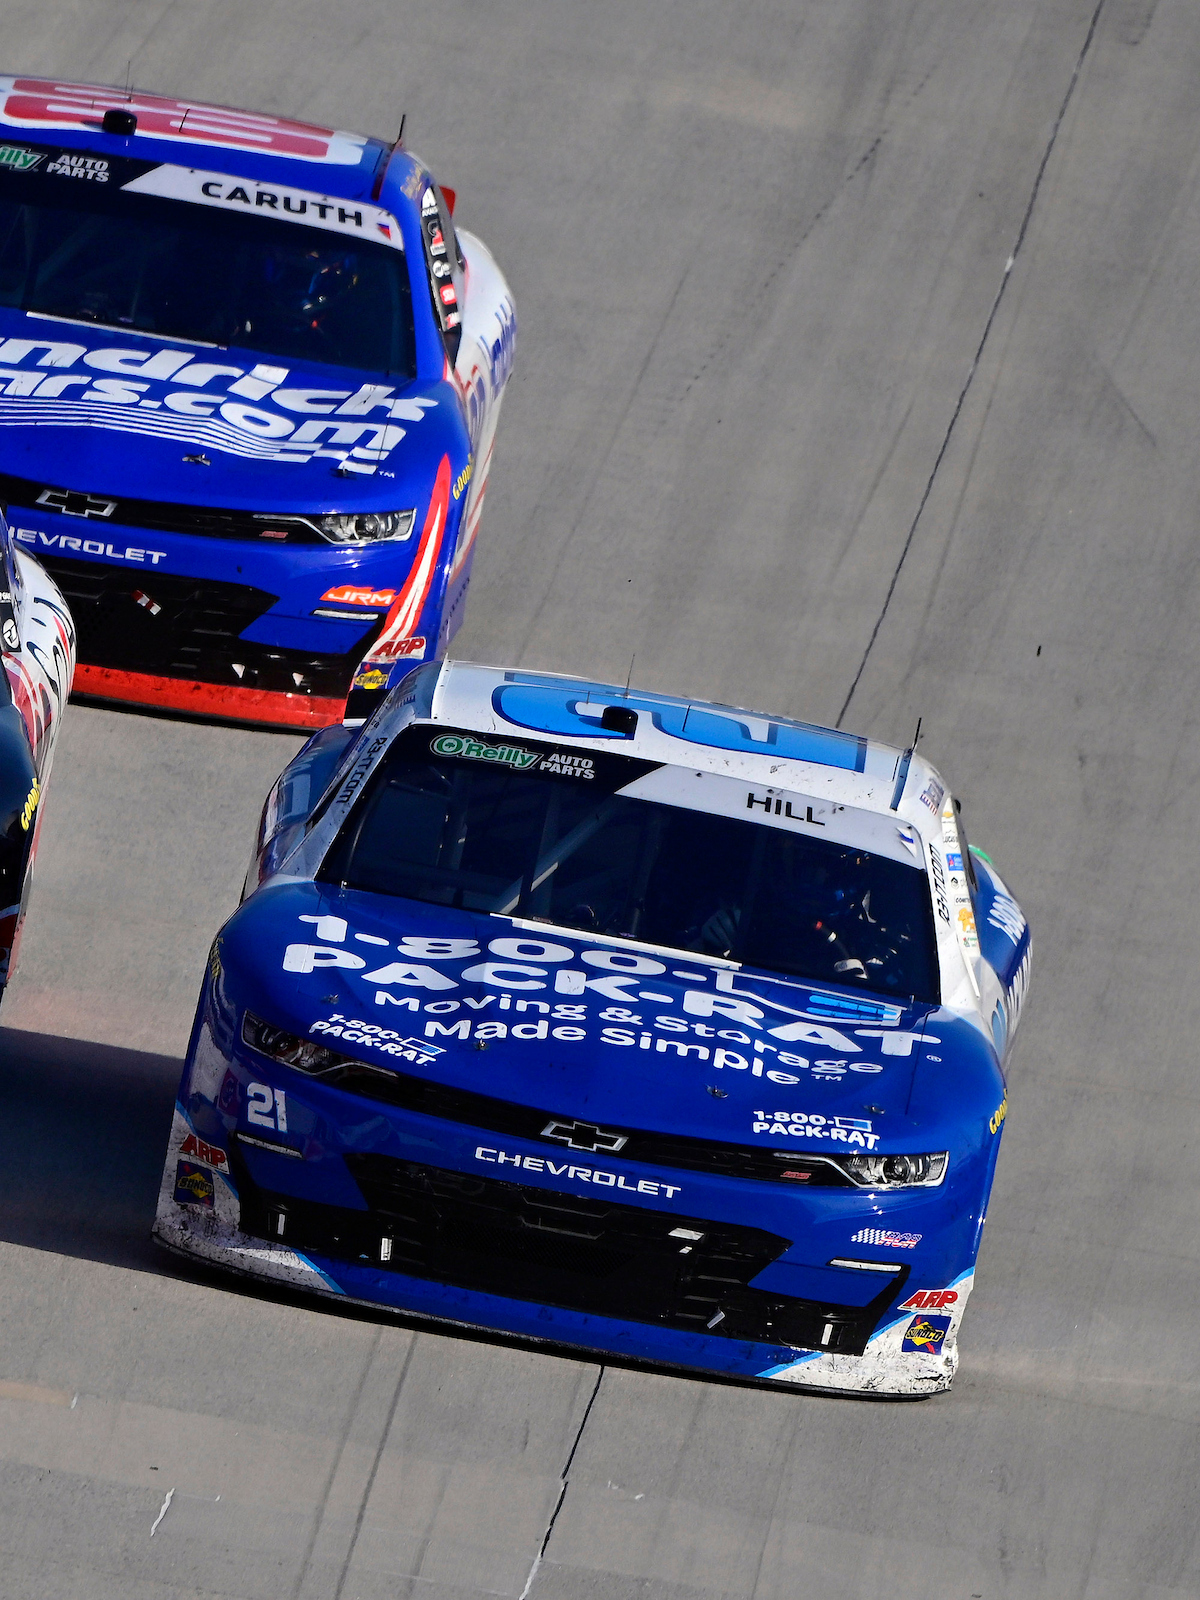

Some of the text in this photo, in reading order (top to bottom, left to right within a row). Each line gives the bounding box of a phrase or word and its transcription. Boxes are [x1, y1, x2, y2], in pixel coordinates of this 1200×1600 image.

[46, 162, 110, 183] PARTS
[57, 154, 109, 172] AUTO
[201, 181, 363, 228] CARUTH
[328, 591, 392, 605] JRM
[373, 637, 426, 658] ARP
[356, 672, 388, 685] SUNOCO
[434, 734, 539, 768] O'Reilly
[548, 753, 594, 769] AUTO
[539, 760, 596, 780] PARTS
[746, 792, 826, 827] HILL
[282, 944, 942, 1057] PACK-RAT
[308, 1021, 438, 1065] PACK-RAT
[374, 990, 884, 1074] Moving & Storage
[424, 1019, 588, 1042] Made
[599, 1027, 801, 1086] Simple
[246, 1082, 289, 1134] 21
[179, 1134, 227, 1166] ARP
[752, 1122, 881, 1150] PACK-RAT
[178, 1177, 214, 1195] SUNOCO
[474, 1146, 682, 1199] CHEVROLET
[903, 1290, 959, 1309] ARP
[905, 1324, 945, 1342] SUNOCO
